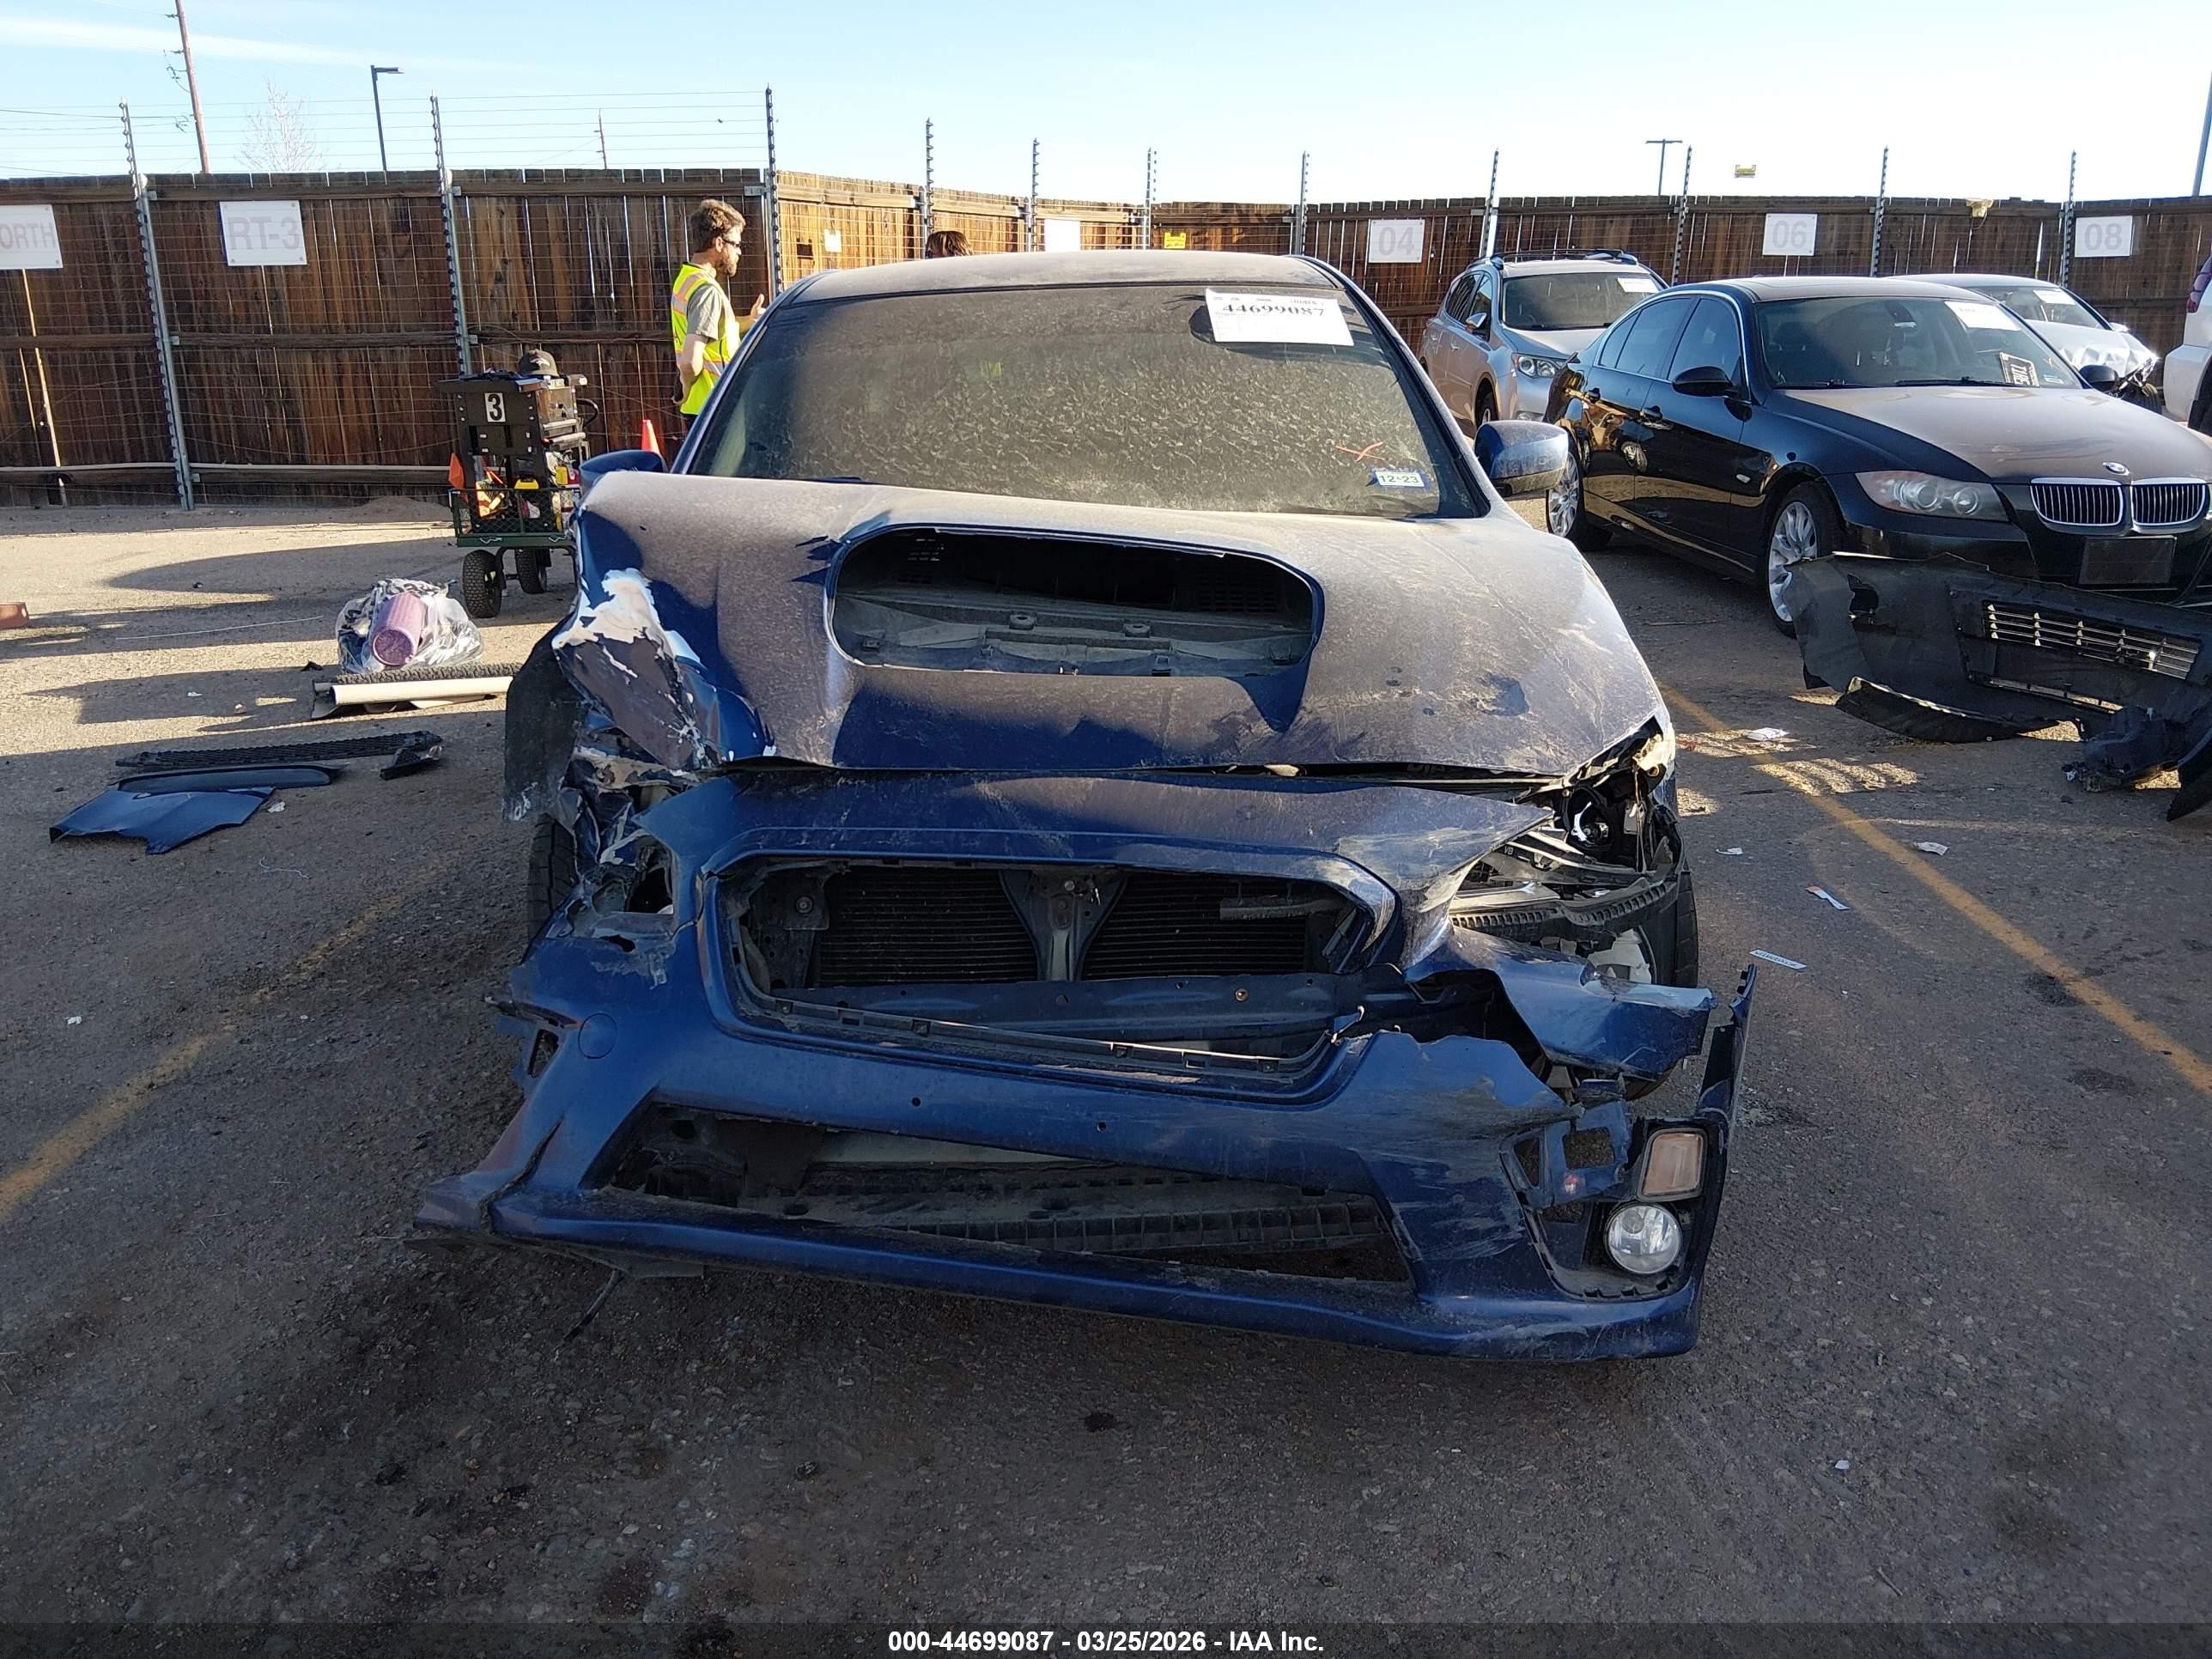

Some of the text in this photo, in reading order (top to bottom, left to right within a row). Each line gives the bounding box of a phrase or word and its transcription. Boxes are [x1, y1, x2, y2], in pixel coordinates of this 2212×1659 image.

[228, 216, 301, 250] RT-3
[1378, 226, 1415, 256] 04
[1772, 220, 1808, 249] 06
[2084, 222, 2123, 250] 08
[1223, 303, 1324, 317] 44699087
[487, 393, 502, 421] 3
